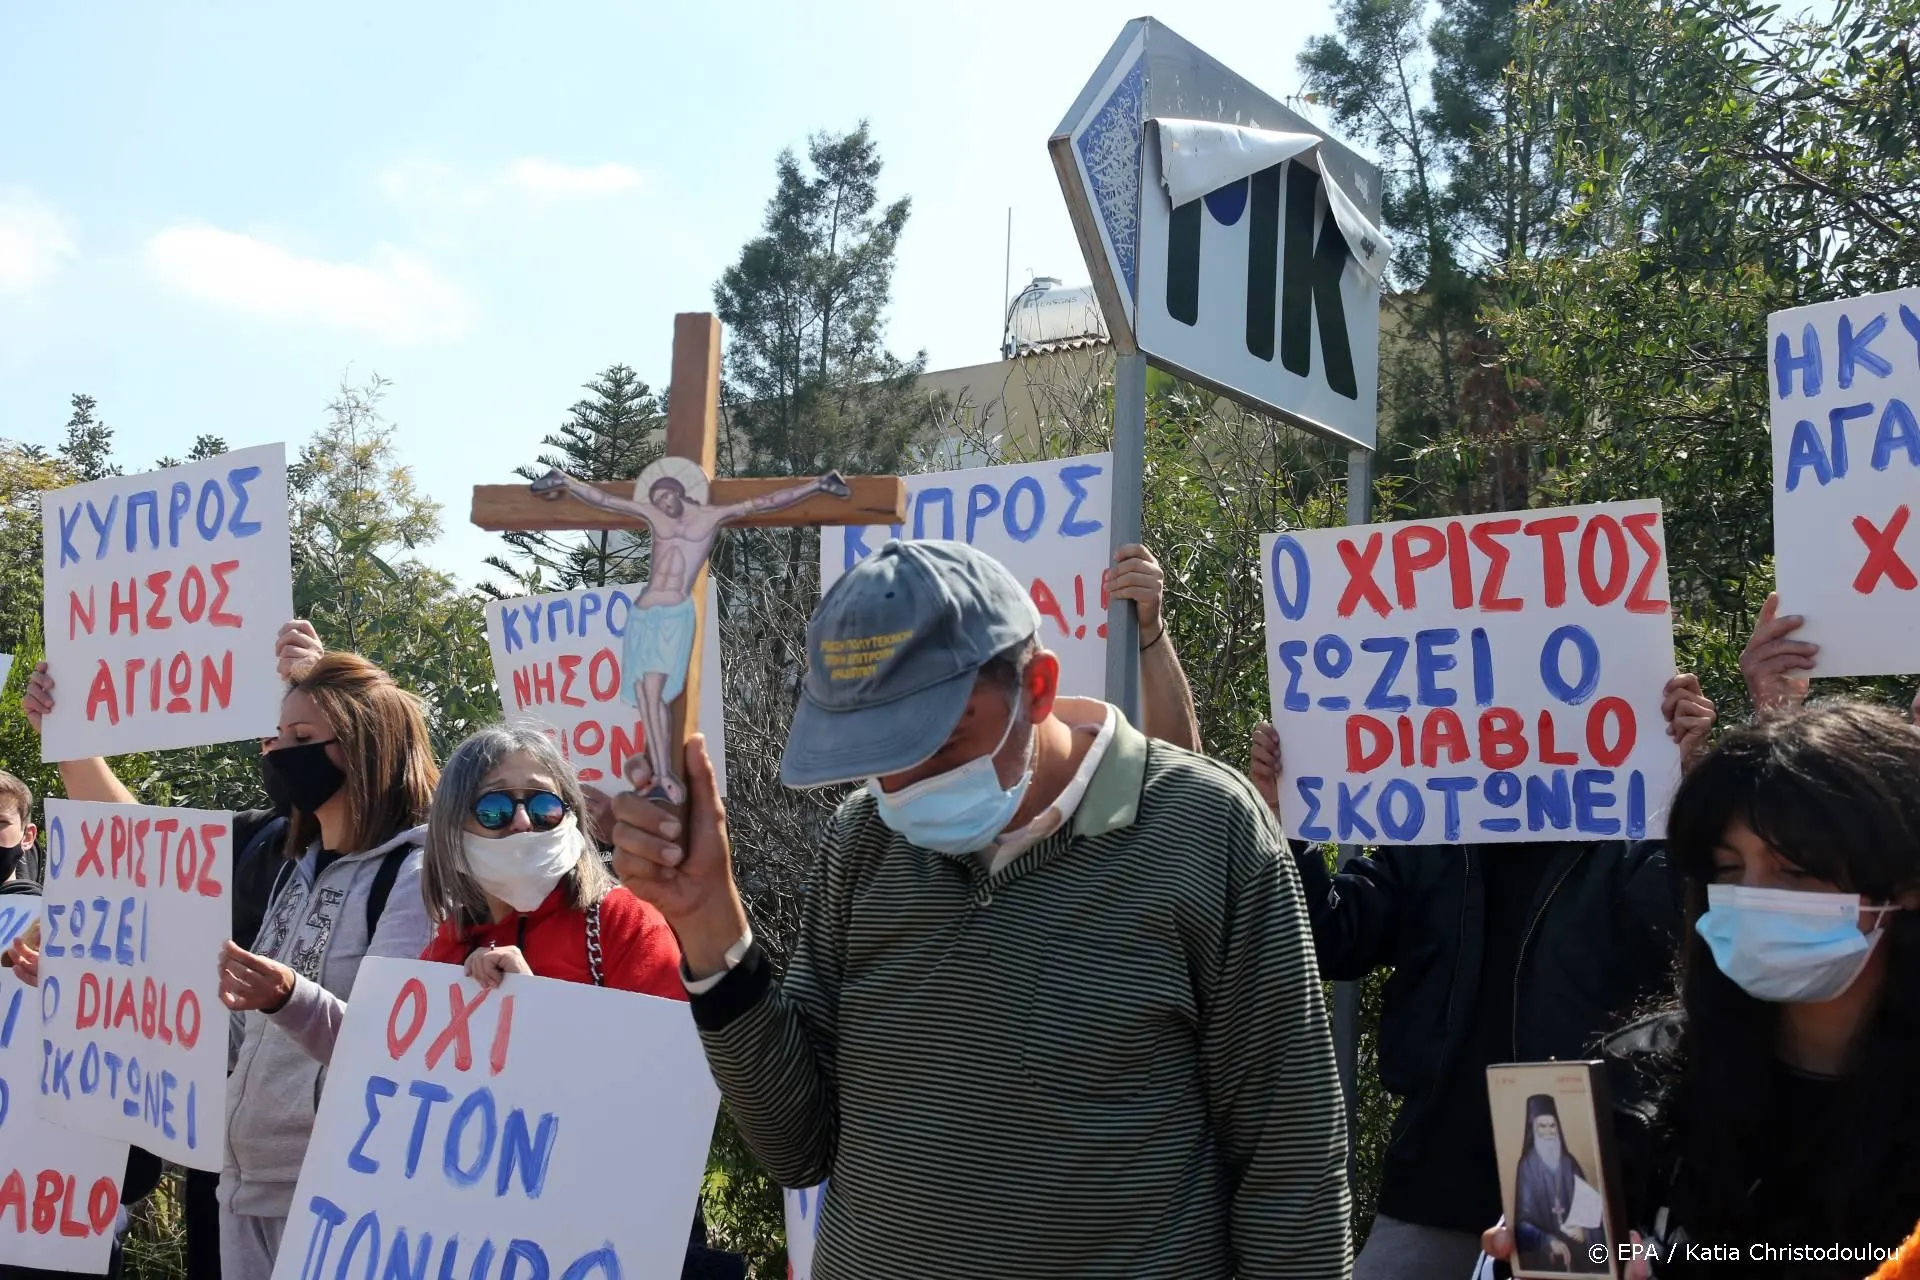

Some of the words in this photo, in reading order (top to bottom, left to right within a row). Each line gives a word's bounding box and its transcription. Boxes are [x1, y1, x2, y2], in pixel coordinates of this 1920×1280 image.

[1785, 398, 1920, 493] ΑΓΑ
[58, 465, 263, 568] ΚΥΠΡΟΣ
[843, 464, 1104, 570] ΚΠΡΟΣ
[1852, 504, 1919, 594] Χ
[68, 559, 244, 641] ΝΗΣΟΣ
[1271, 534, 1311, 621] Ο
[1337, 512, 1671, 619] ΧΡΙΣΤΟΣ
[501, 590, 633, 654] ΚΥΠΡΟ
[86, 649, 234, 726] ΑΓΙΩΝ
[513, 647, 621, 711] ΝΗΣΟ
[1279, 627, 1495, 712] ΣΩΖΕΙ
[1540, 624, 1601, 706] Ο
[1345, 696, 1637, 773] DIABLO
[1296, 768, 1646, 842] ΣΚΟΤΩΝΕΙ
[50, 815, 65, 880] Ο
[75, 814, 227, 897] ΧΡΙΣΤΟΣ
[45, 896, 149, 966] ΣΩΖΕΙ
[76, 972, 202, 1050] DIABLO
[387, 977, 515, 1077] ΟΧΙ
[40, 1039, 197, 1150] ΣΚΟΤΩΝΕΙ
[347, 1075, 559, 1199] ΣΤΟΝ
[0, 1168, 119, 1238] ABLO
